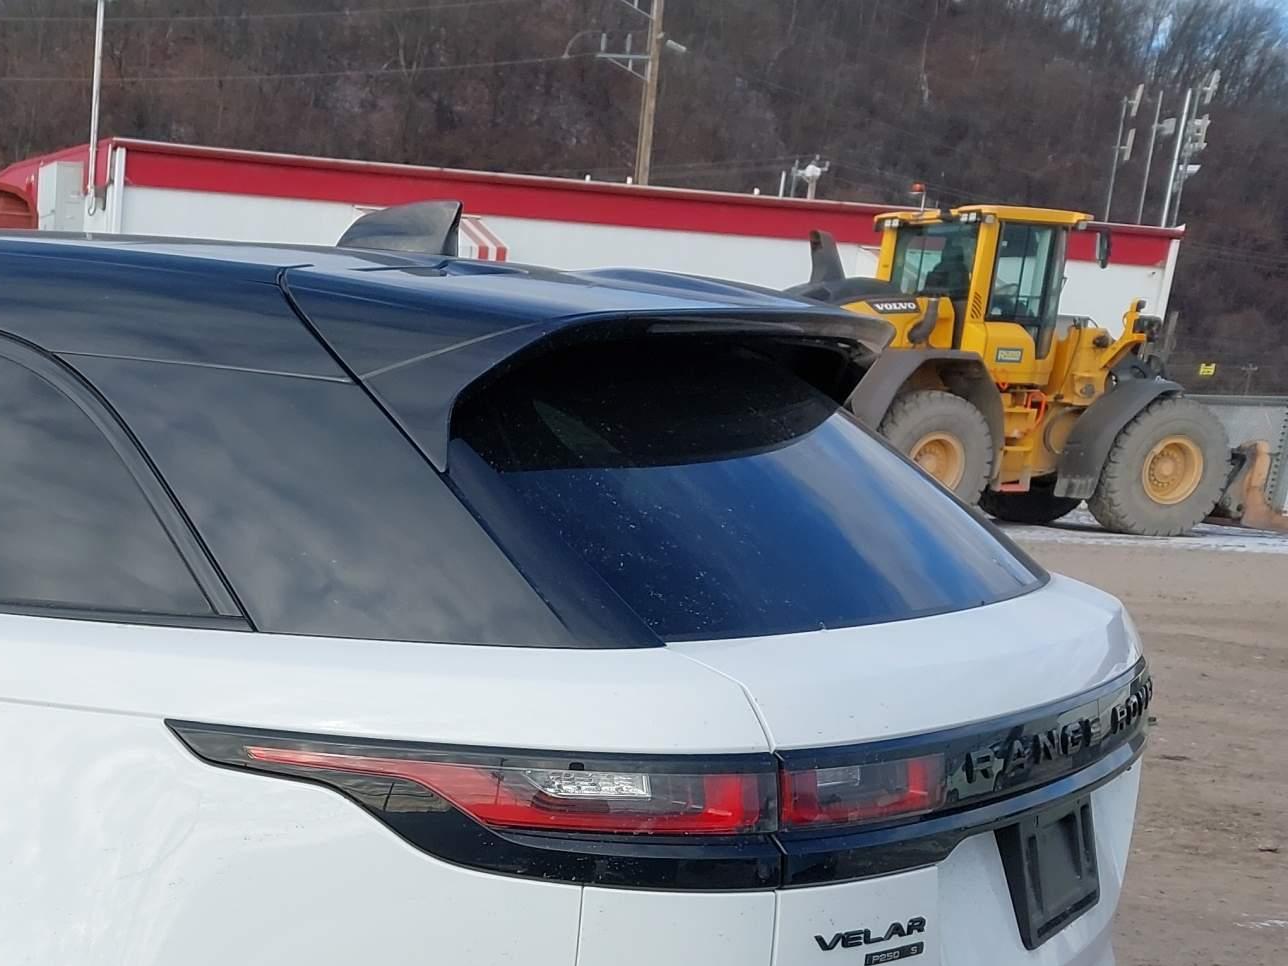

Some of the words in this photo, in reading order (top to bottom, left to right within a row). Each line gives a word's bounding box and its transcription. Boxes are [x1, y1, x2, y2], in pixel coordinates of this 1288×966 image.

[873, 302, 917, 311] VOLVO
[964, 717, 1101, 784] RANGE
[814, 916, 926, 951] VELAR
[872, 951, 900, 964] P250
